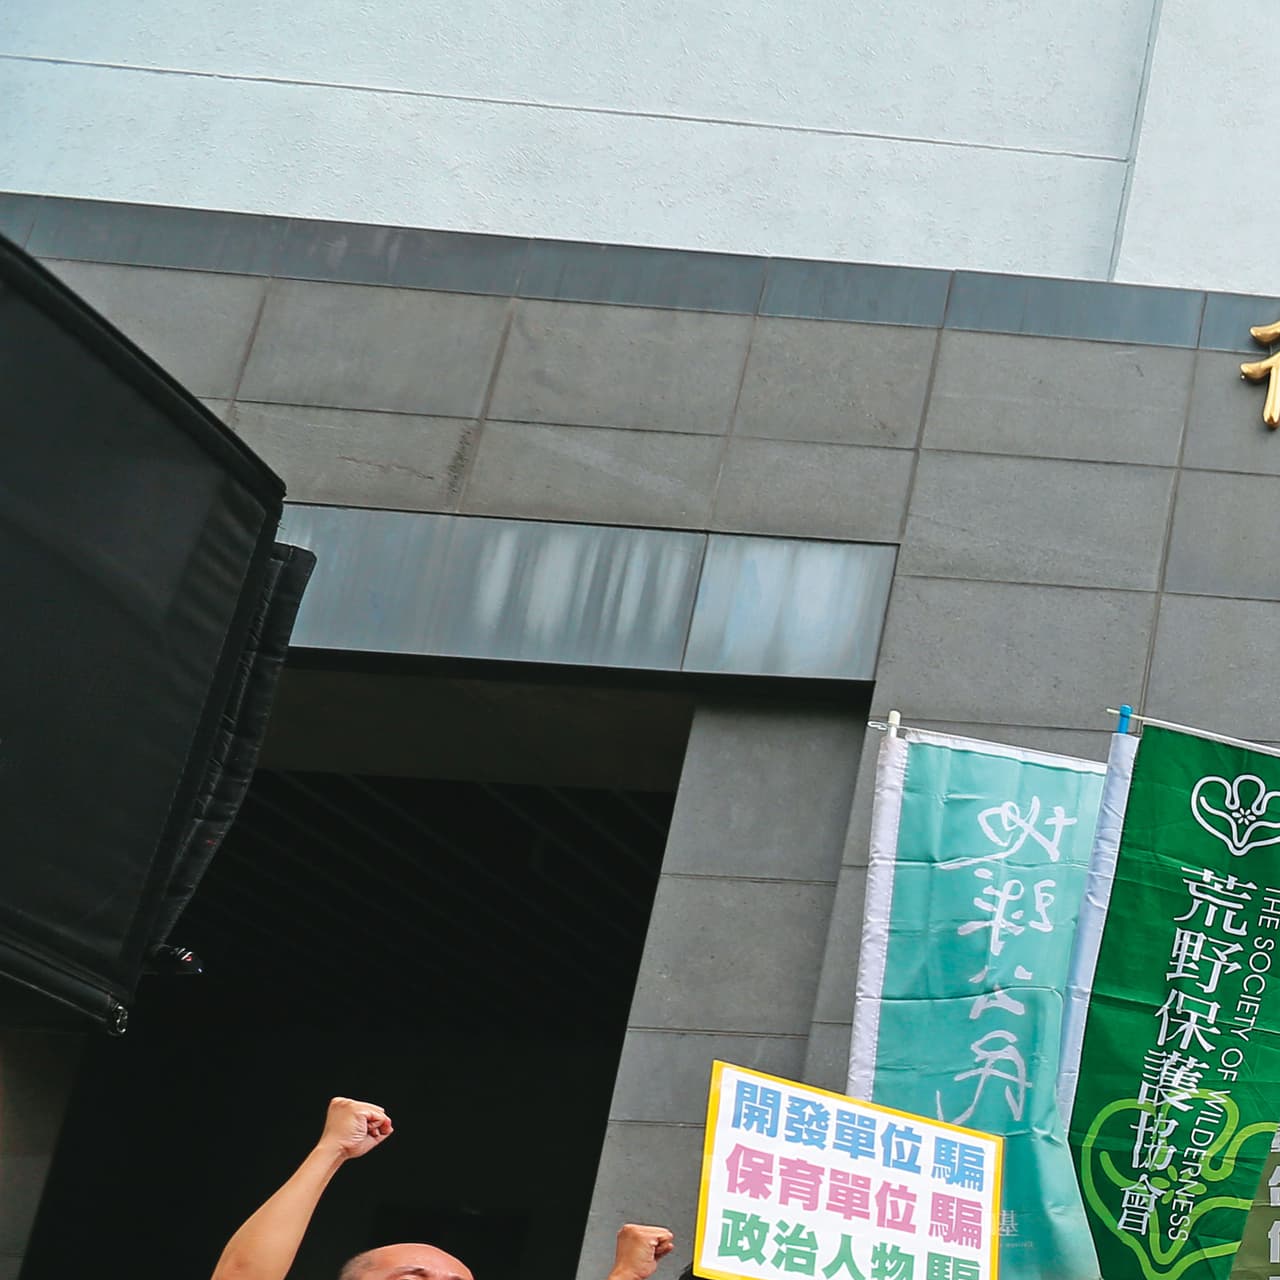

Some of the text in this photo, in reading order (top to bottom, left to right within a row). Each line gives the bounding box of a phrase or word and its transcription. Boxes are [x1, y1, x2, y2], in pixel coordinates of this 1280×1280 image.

[1116, 866, 1259, 1237] 荒野保護協會
[1235, 937, 1275, 1041] SOCIETY
[1216, 1046, 1245, 1082] OF
[1167, 1087, 1225, 1242] WILDERNESS
